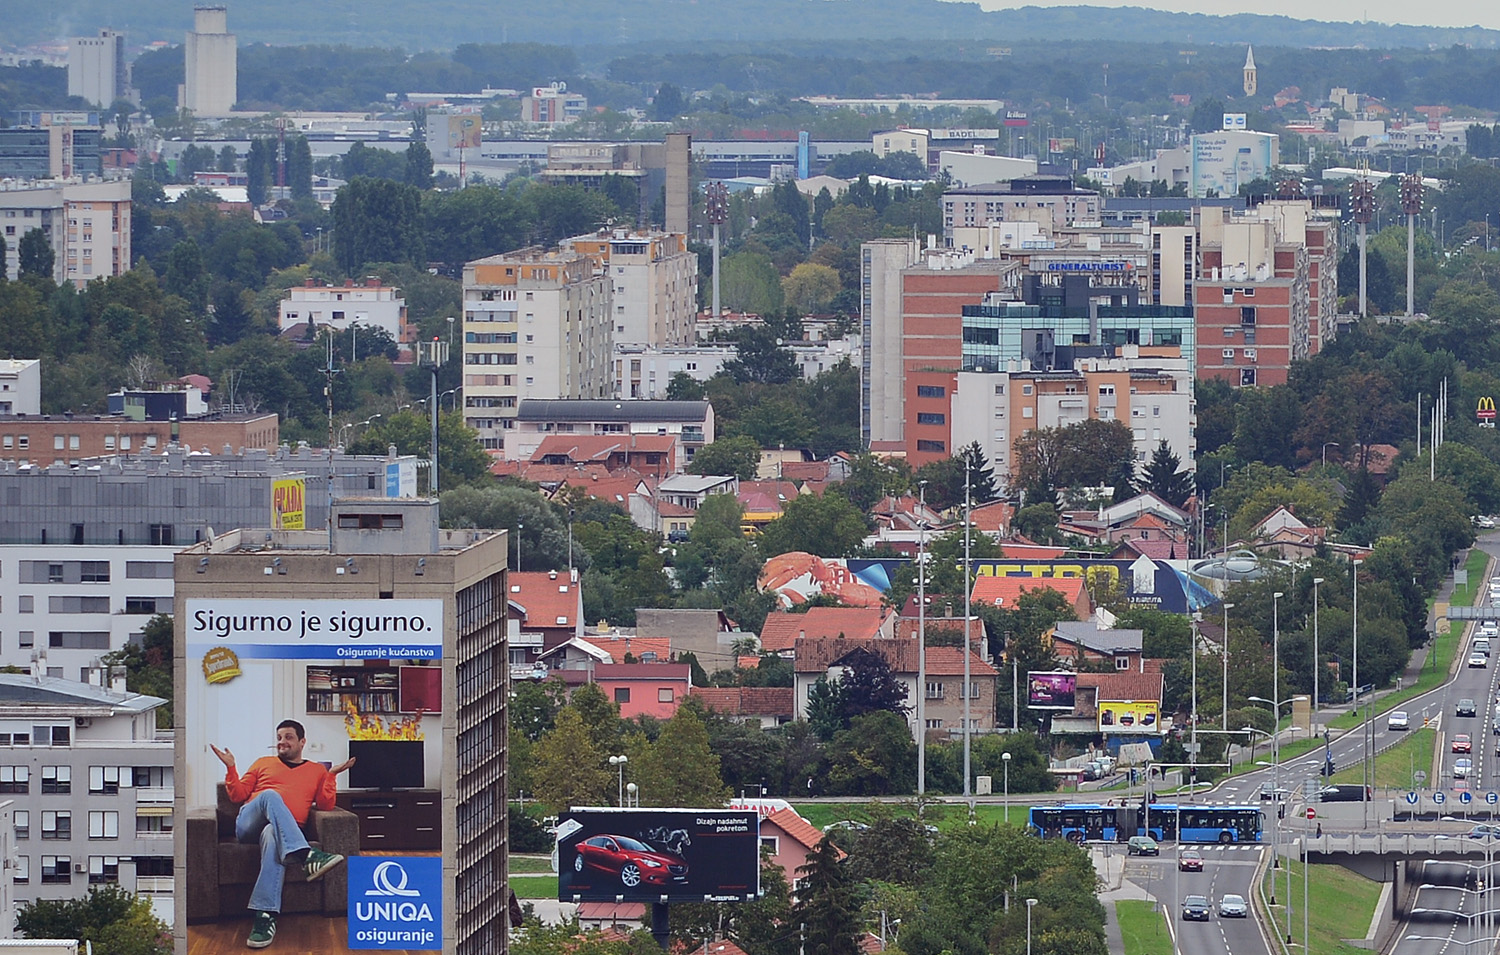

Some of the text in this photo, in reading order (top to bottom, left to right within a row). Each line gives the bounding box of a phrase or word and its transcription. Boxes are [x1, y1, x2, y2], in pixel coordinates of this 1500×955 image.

[949, 130, 978, 138] BADEL
[1048, 263, 1125, 271] GENERALTURIST
[193, 609, 432, 639] Sigurno je sigurno.
[337, 647, 434, 659] Osiguranje kućanstva
[696, 818, 717, 826] Dizajn
[356, 902, 434, 922] UNIQA
[356, 927, 434, 945] osiguranje
